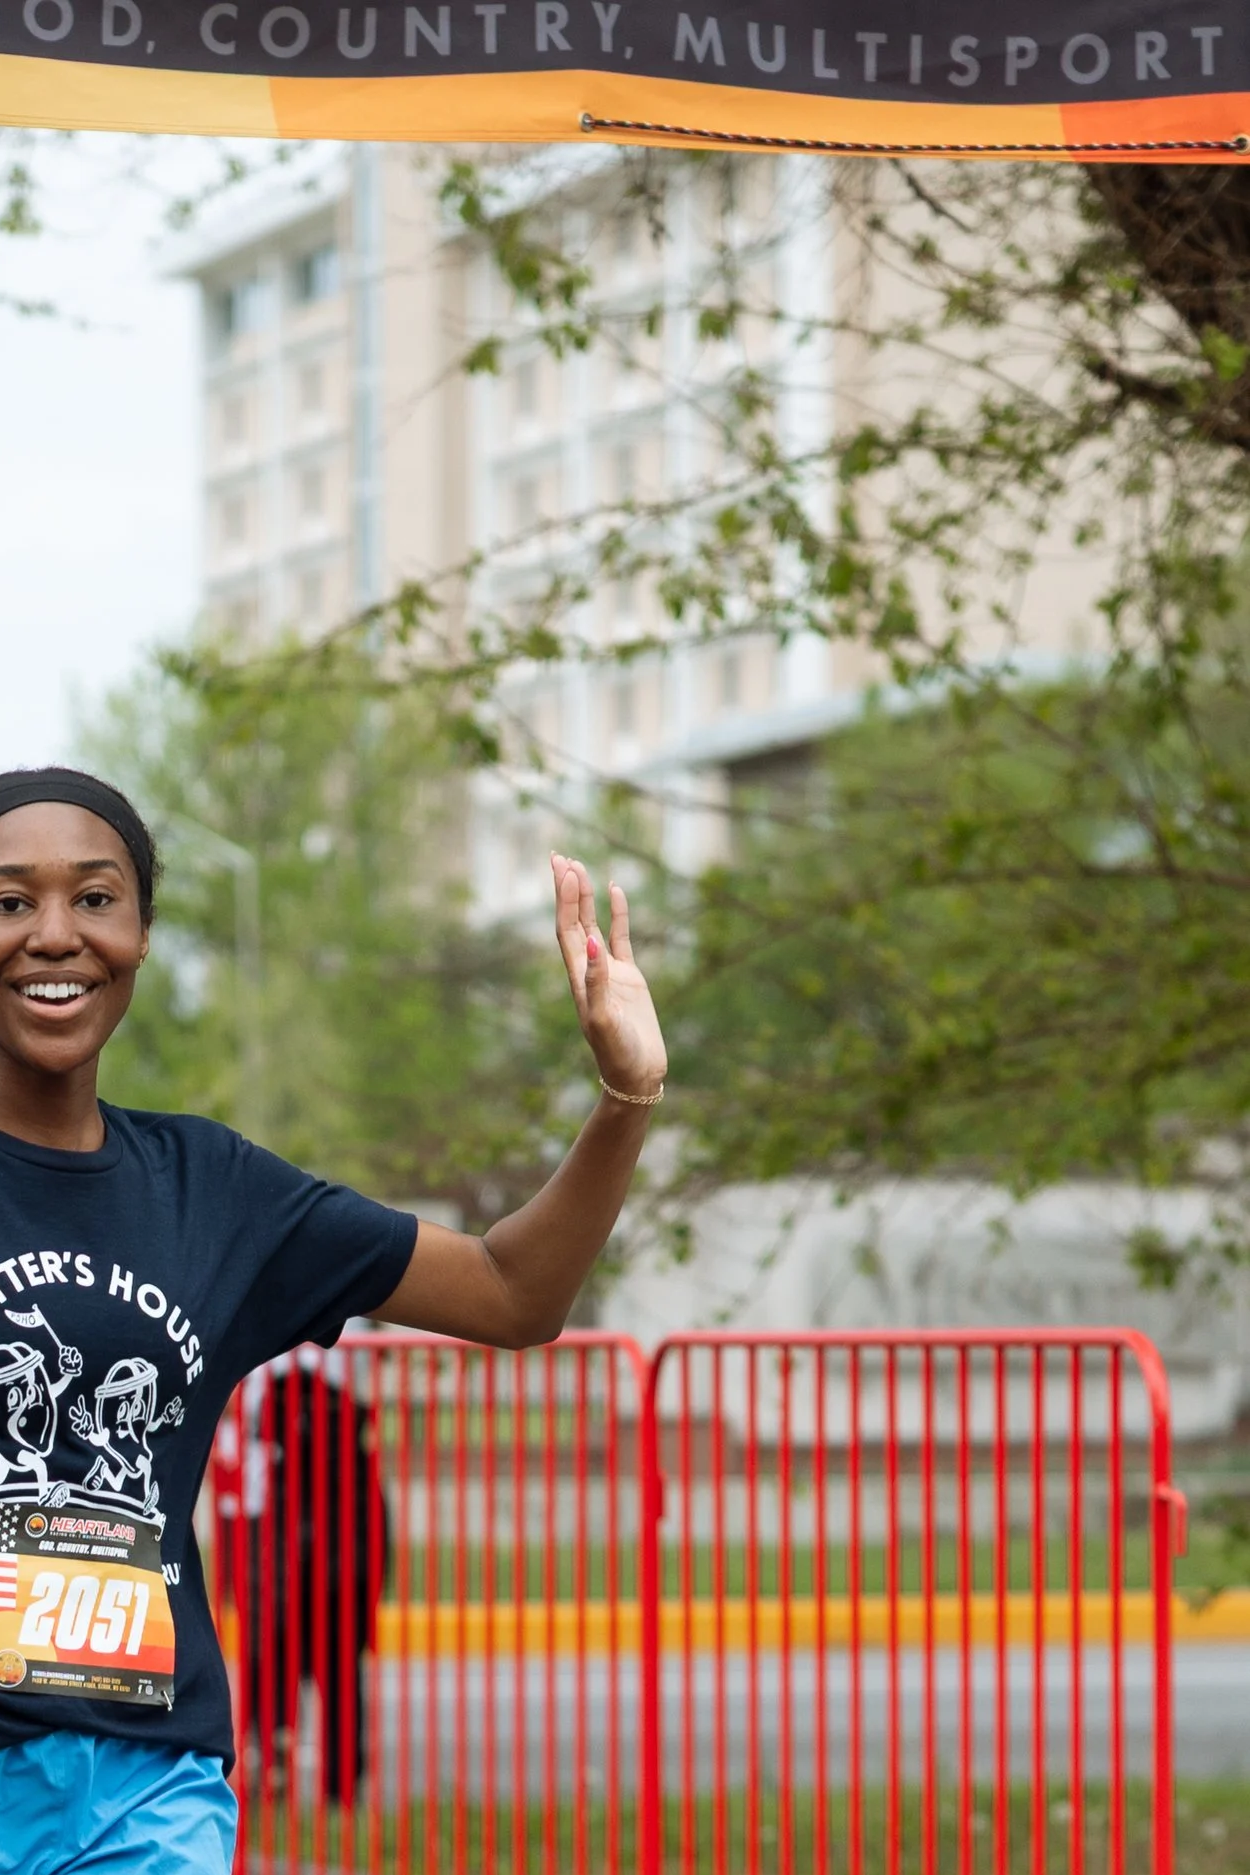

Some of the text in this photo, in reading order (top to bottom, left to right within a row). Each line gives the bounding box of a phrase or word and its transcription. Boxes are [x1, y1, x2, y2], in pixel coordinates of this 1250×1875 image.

[200, 3, 635, 59] COUNTRY,
[673, 13, 1224, 87] MULTISPORT
[109, 1264, 204, 1385] HOUSE
[50, 1516, 136, 1541] HEARTLAND
[18, 1572, 150, 1656] 2051
